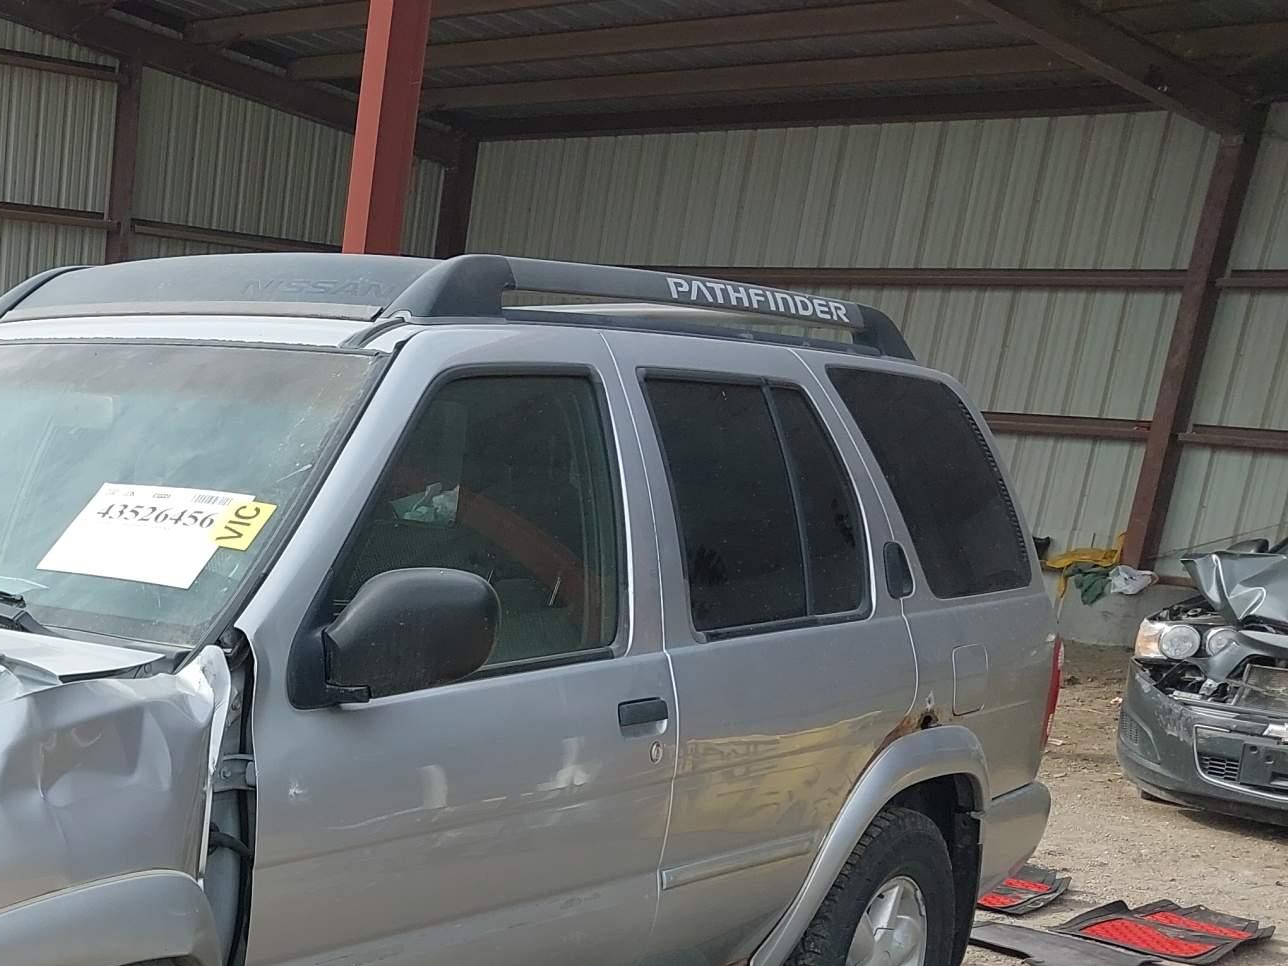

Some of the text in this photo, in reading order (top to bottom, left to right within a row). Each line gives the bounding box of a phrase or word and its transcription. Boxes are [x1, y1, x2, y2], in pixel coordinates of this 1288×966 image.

[242, 278, 391, 297] NISSAN
[666, 277, 850, 322] PATHFINDER
[97, 503, 217, 528] 43526456
[215, 505, 261, 541] VIC
